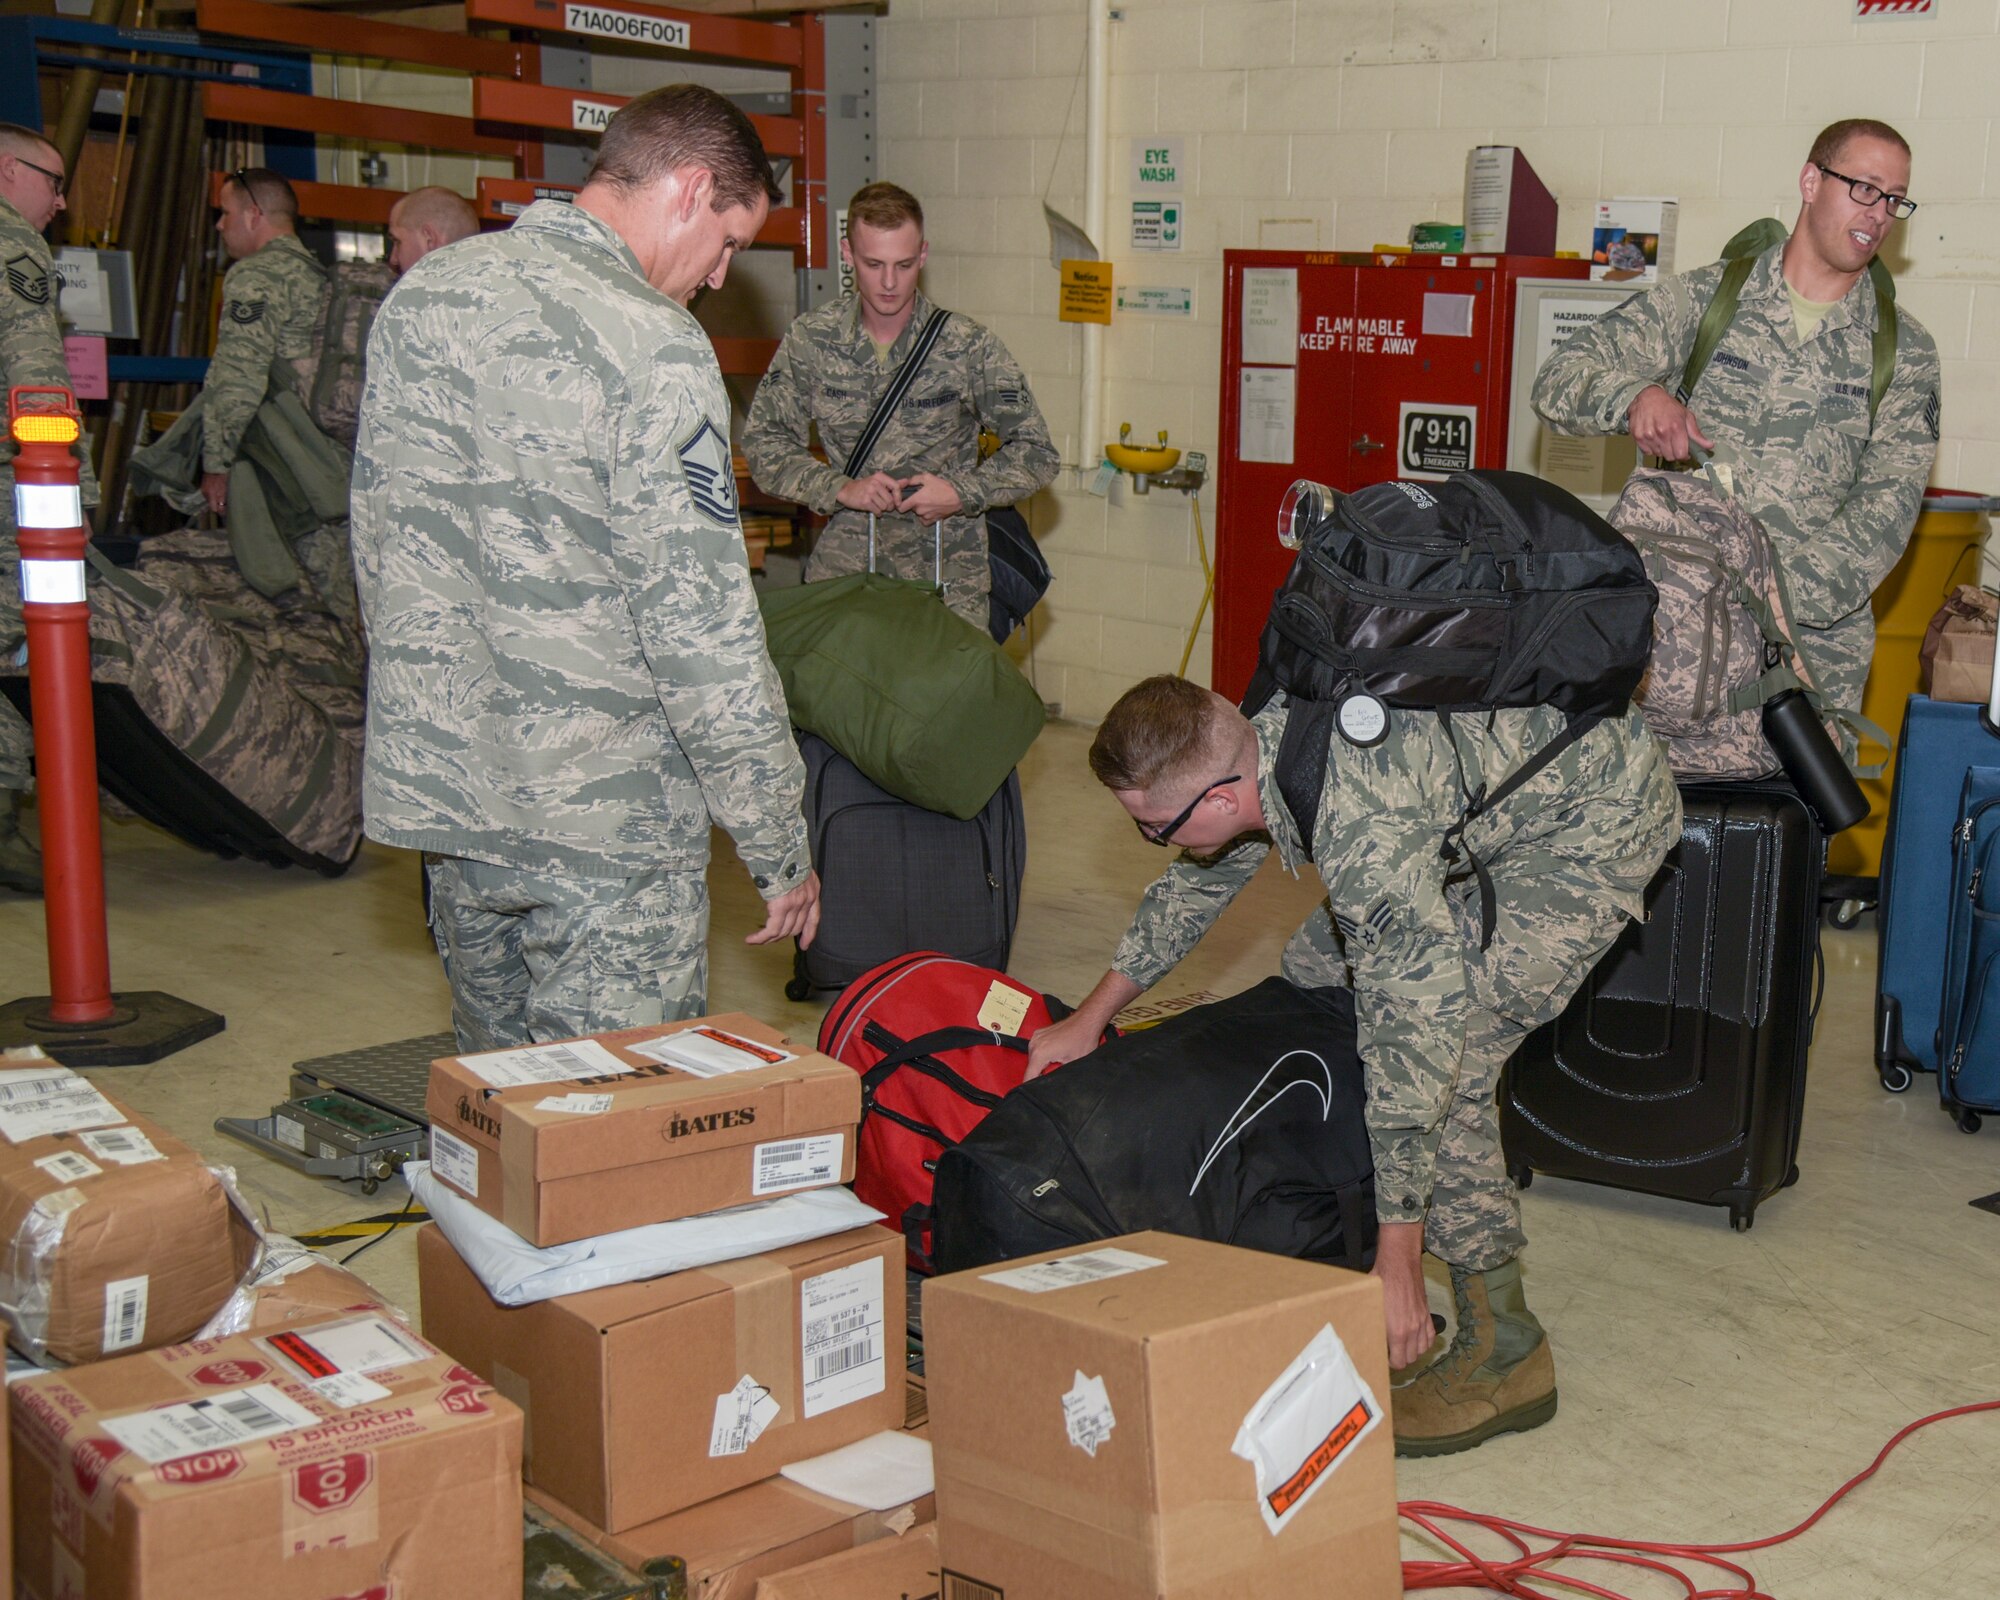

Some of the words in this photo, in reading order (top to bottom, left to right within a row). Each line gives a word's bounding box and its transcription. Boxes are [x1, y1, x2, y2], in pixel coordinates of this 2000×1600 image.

[569, 8, 685, 44] 71A006F001
[1145, 149, 1169, 164] EYE
[1139, 168, 1175, 182] WASH
[1305, 254, 1334, 264] PAINT
[1300, 333, 1334, 350] KEEP
[1381, 338, 1417, 355] AWAY
[1712, 350, 1749, 371] JOHNSON
[826, 388, 847, 399] CASH
[1834, 382, 1848, 395] U.S.
[1851, 384, 1865, 398] AIR
[1427, 418, 1466, 447] 9-1-1
[1423, 457, 1466, 469] EMERGENCY
[670, 1107, 756, 1139] BATES
[268, 1436, 294, 1452] IS
[302, 1406, 415, 1444] BROKEN
[338, 1421, 416, 1445] CONTENTS
[163, 1450, 235, 1480] STOP
[319, 1458, 347, 1503] TOP
